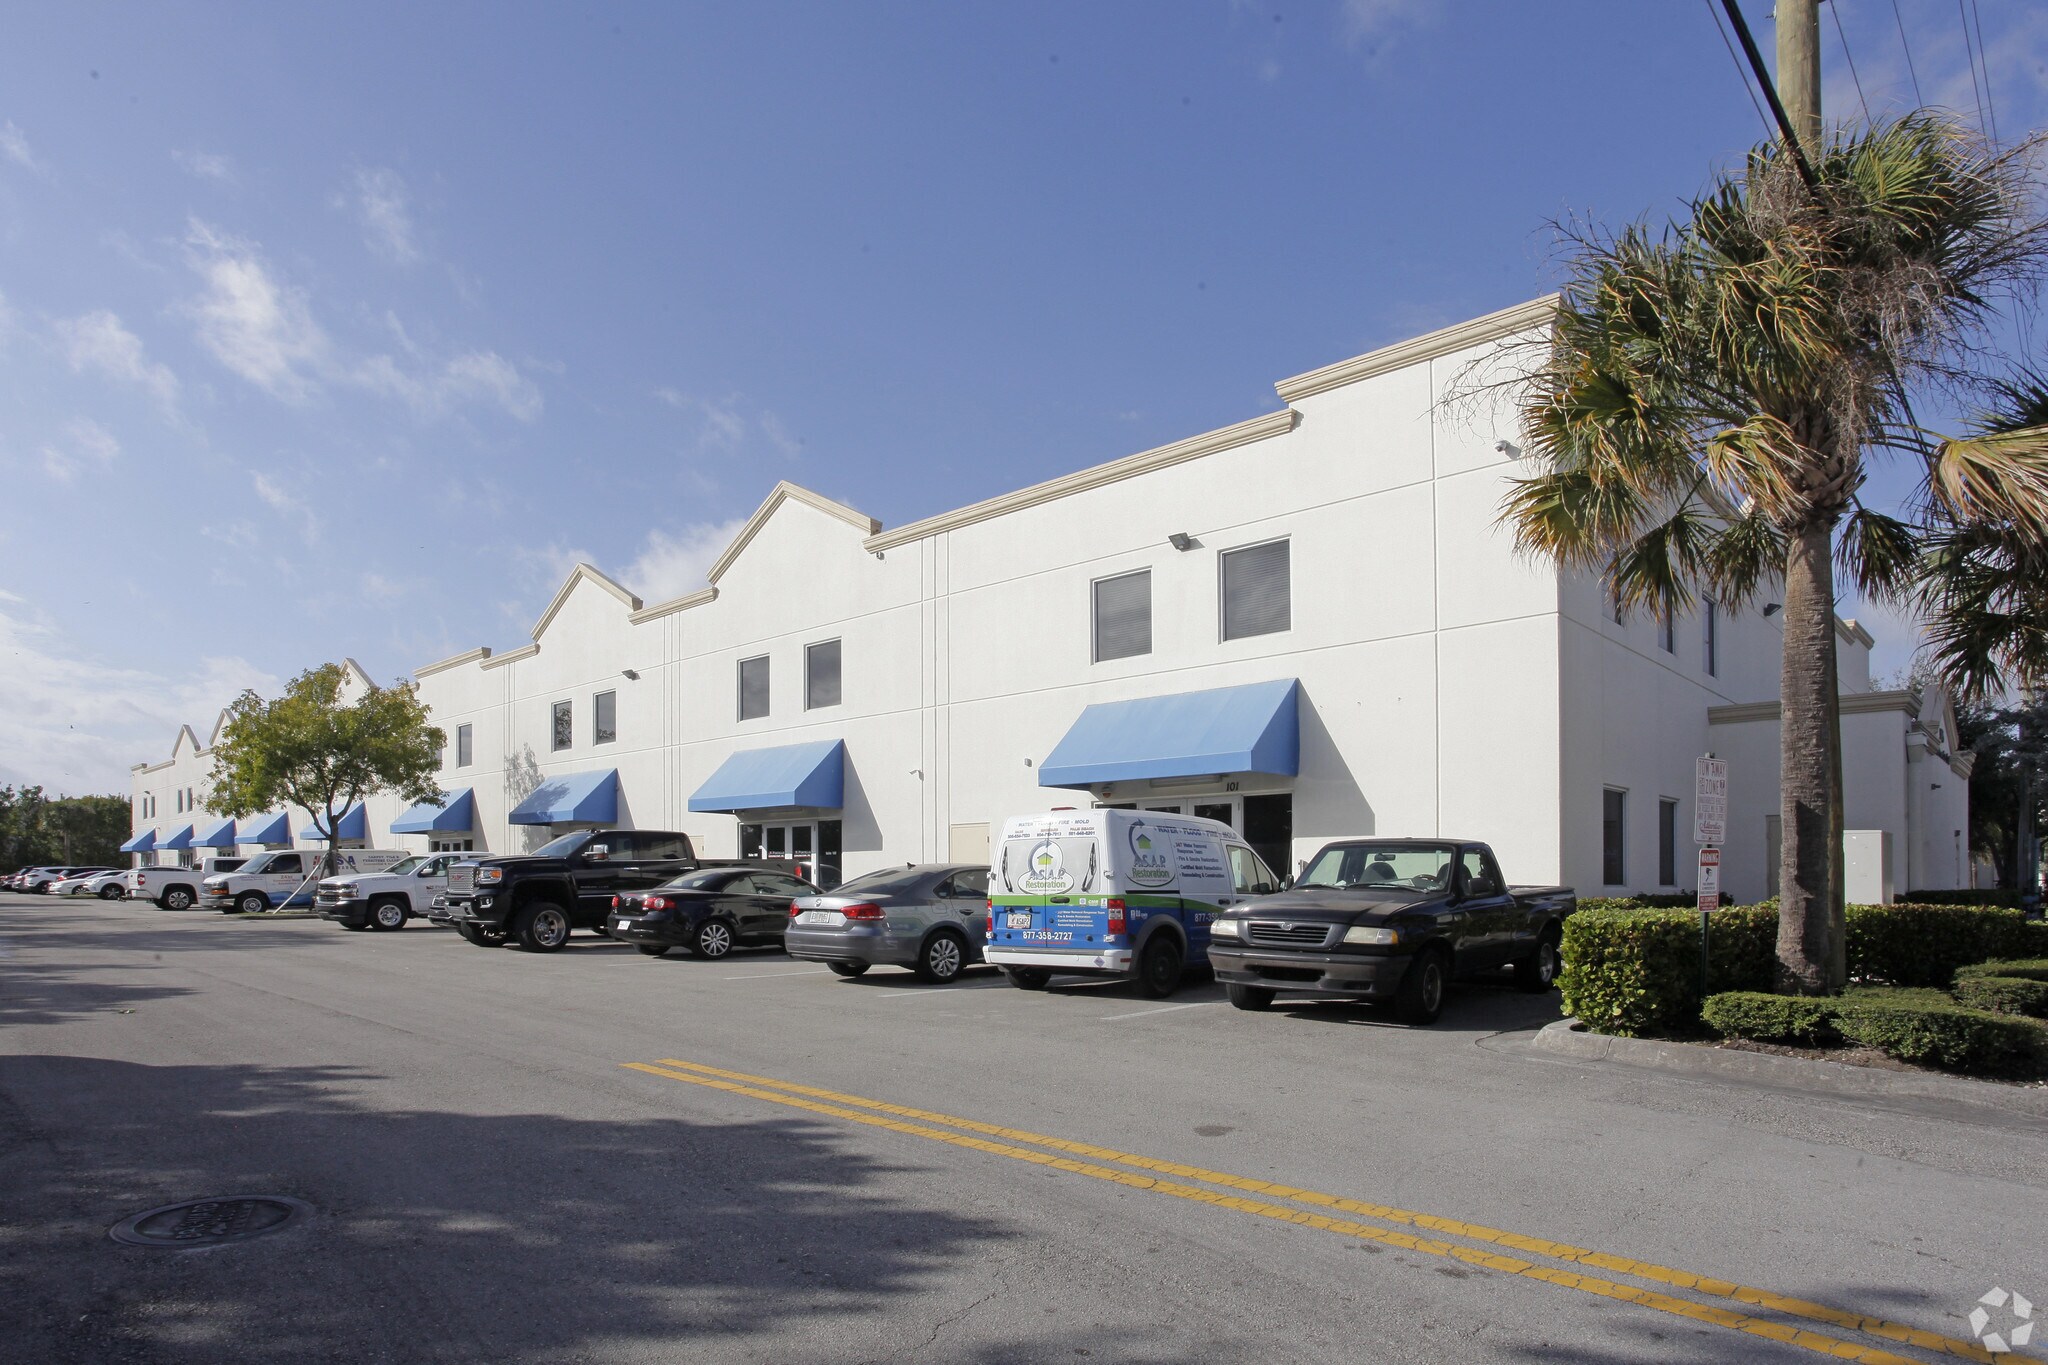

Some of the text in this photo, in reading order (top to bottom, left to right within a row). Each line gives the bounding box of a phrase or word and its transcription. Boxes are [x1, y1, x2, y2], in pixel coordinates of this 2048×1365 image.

[1698, 760, 1726, 778] TOW AWAY
[1226, 781, 1239, 792] 101
[1705, 779, 1719, 795] ZONE
[1156, 825, 1178, 834] WATER
[1181, 827, 1202, 836] FLOOD
[1222, 832, 1238, 840] MOLD
[1132, 867, 1170, 879] Restoration
[1025, 880, 1066, 889] Restoration
[1022, 931, 1073, 940] 877-358-2727
